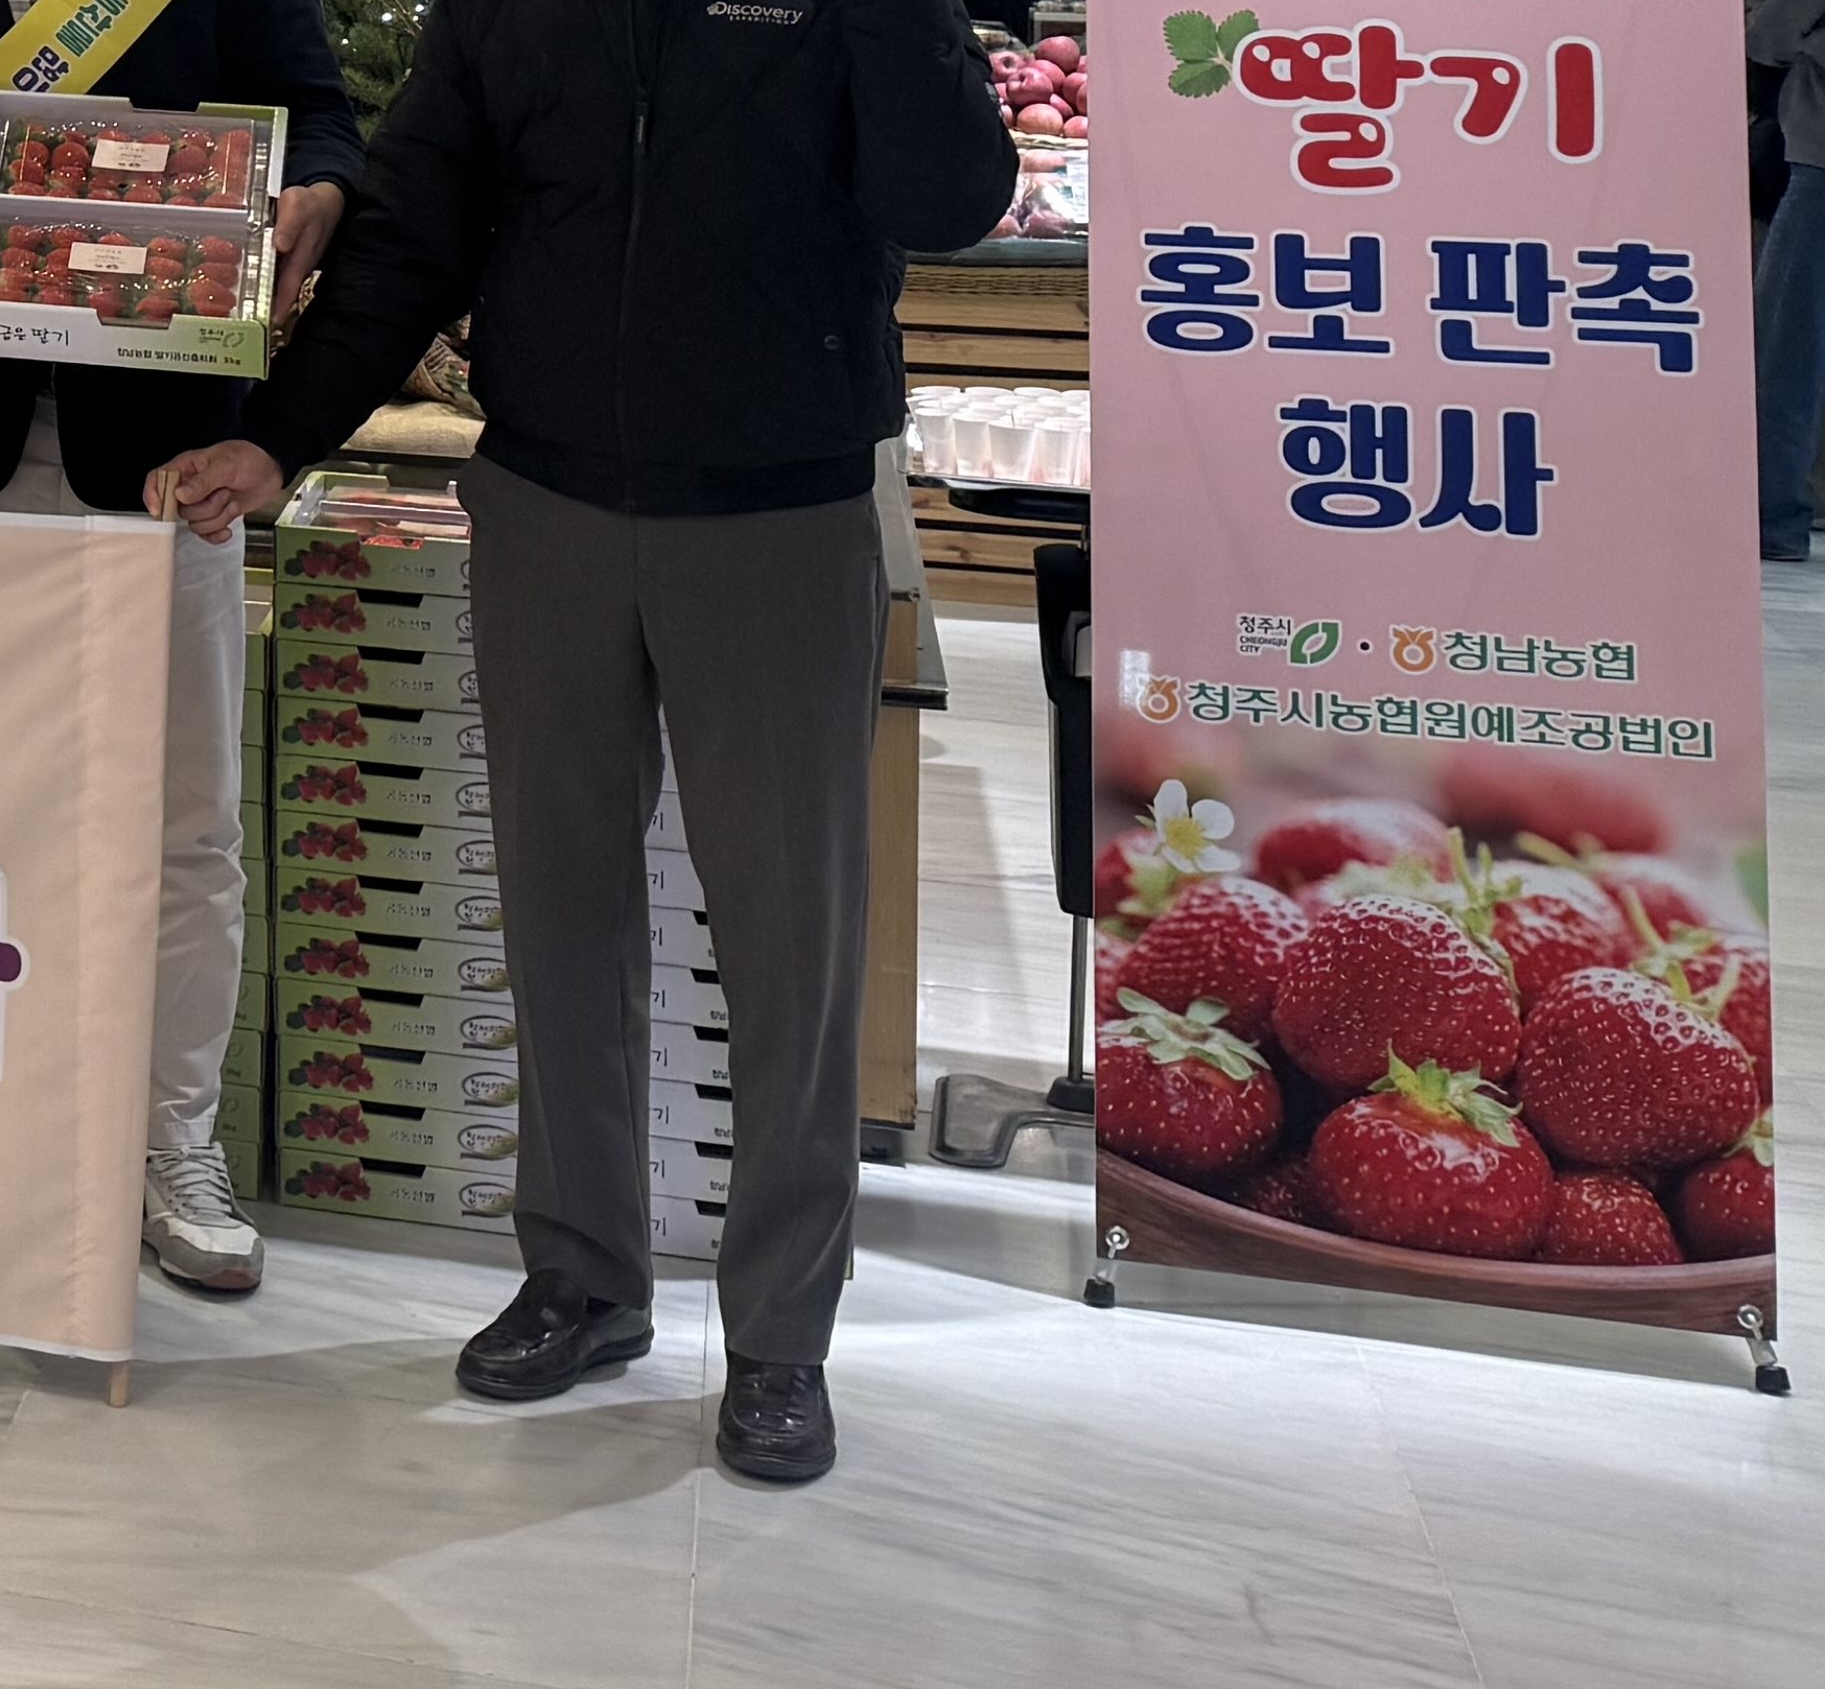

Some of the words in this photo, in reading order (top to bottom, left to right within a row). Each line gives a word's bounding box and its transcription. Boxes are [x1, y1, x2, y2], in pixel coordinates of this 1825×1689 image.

[1237, 23, 1597, 190] 딸기
[1138, 223, 1395, 356] 홍보
[1427, 239, 1703, 376] 판촉
[1277, 395, 1557, 539] 행사
[1238, 615, 1292, 636] 청주시
[1238, 644, 1262, 653] CITY
[1442, 630, 1636, 682] 청남농협
[1185, 681, 1715, 761] 청주시농협원예조공법인
